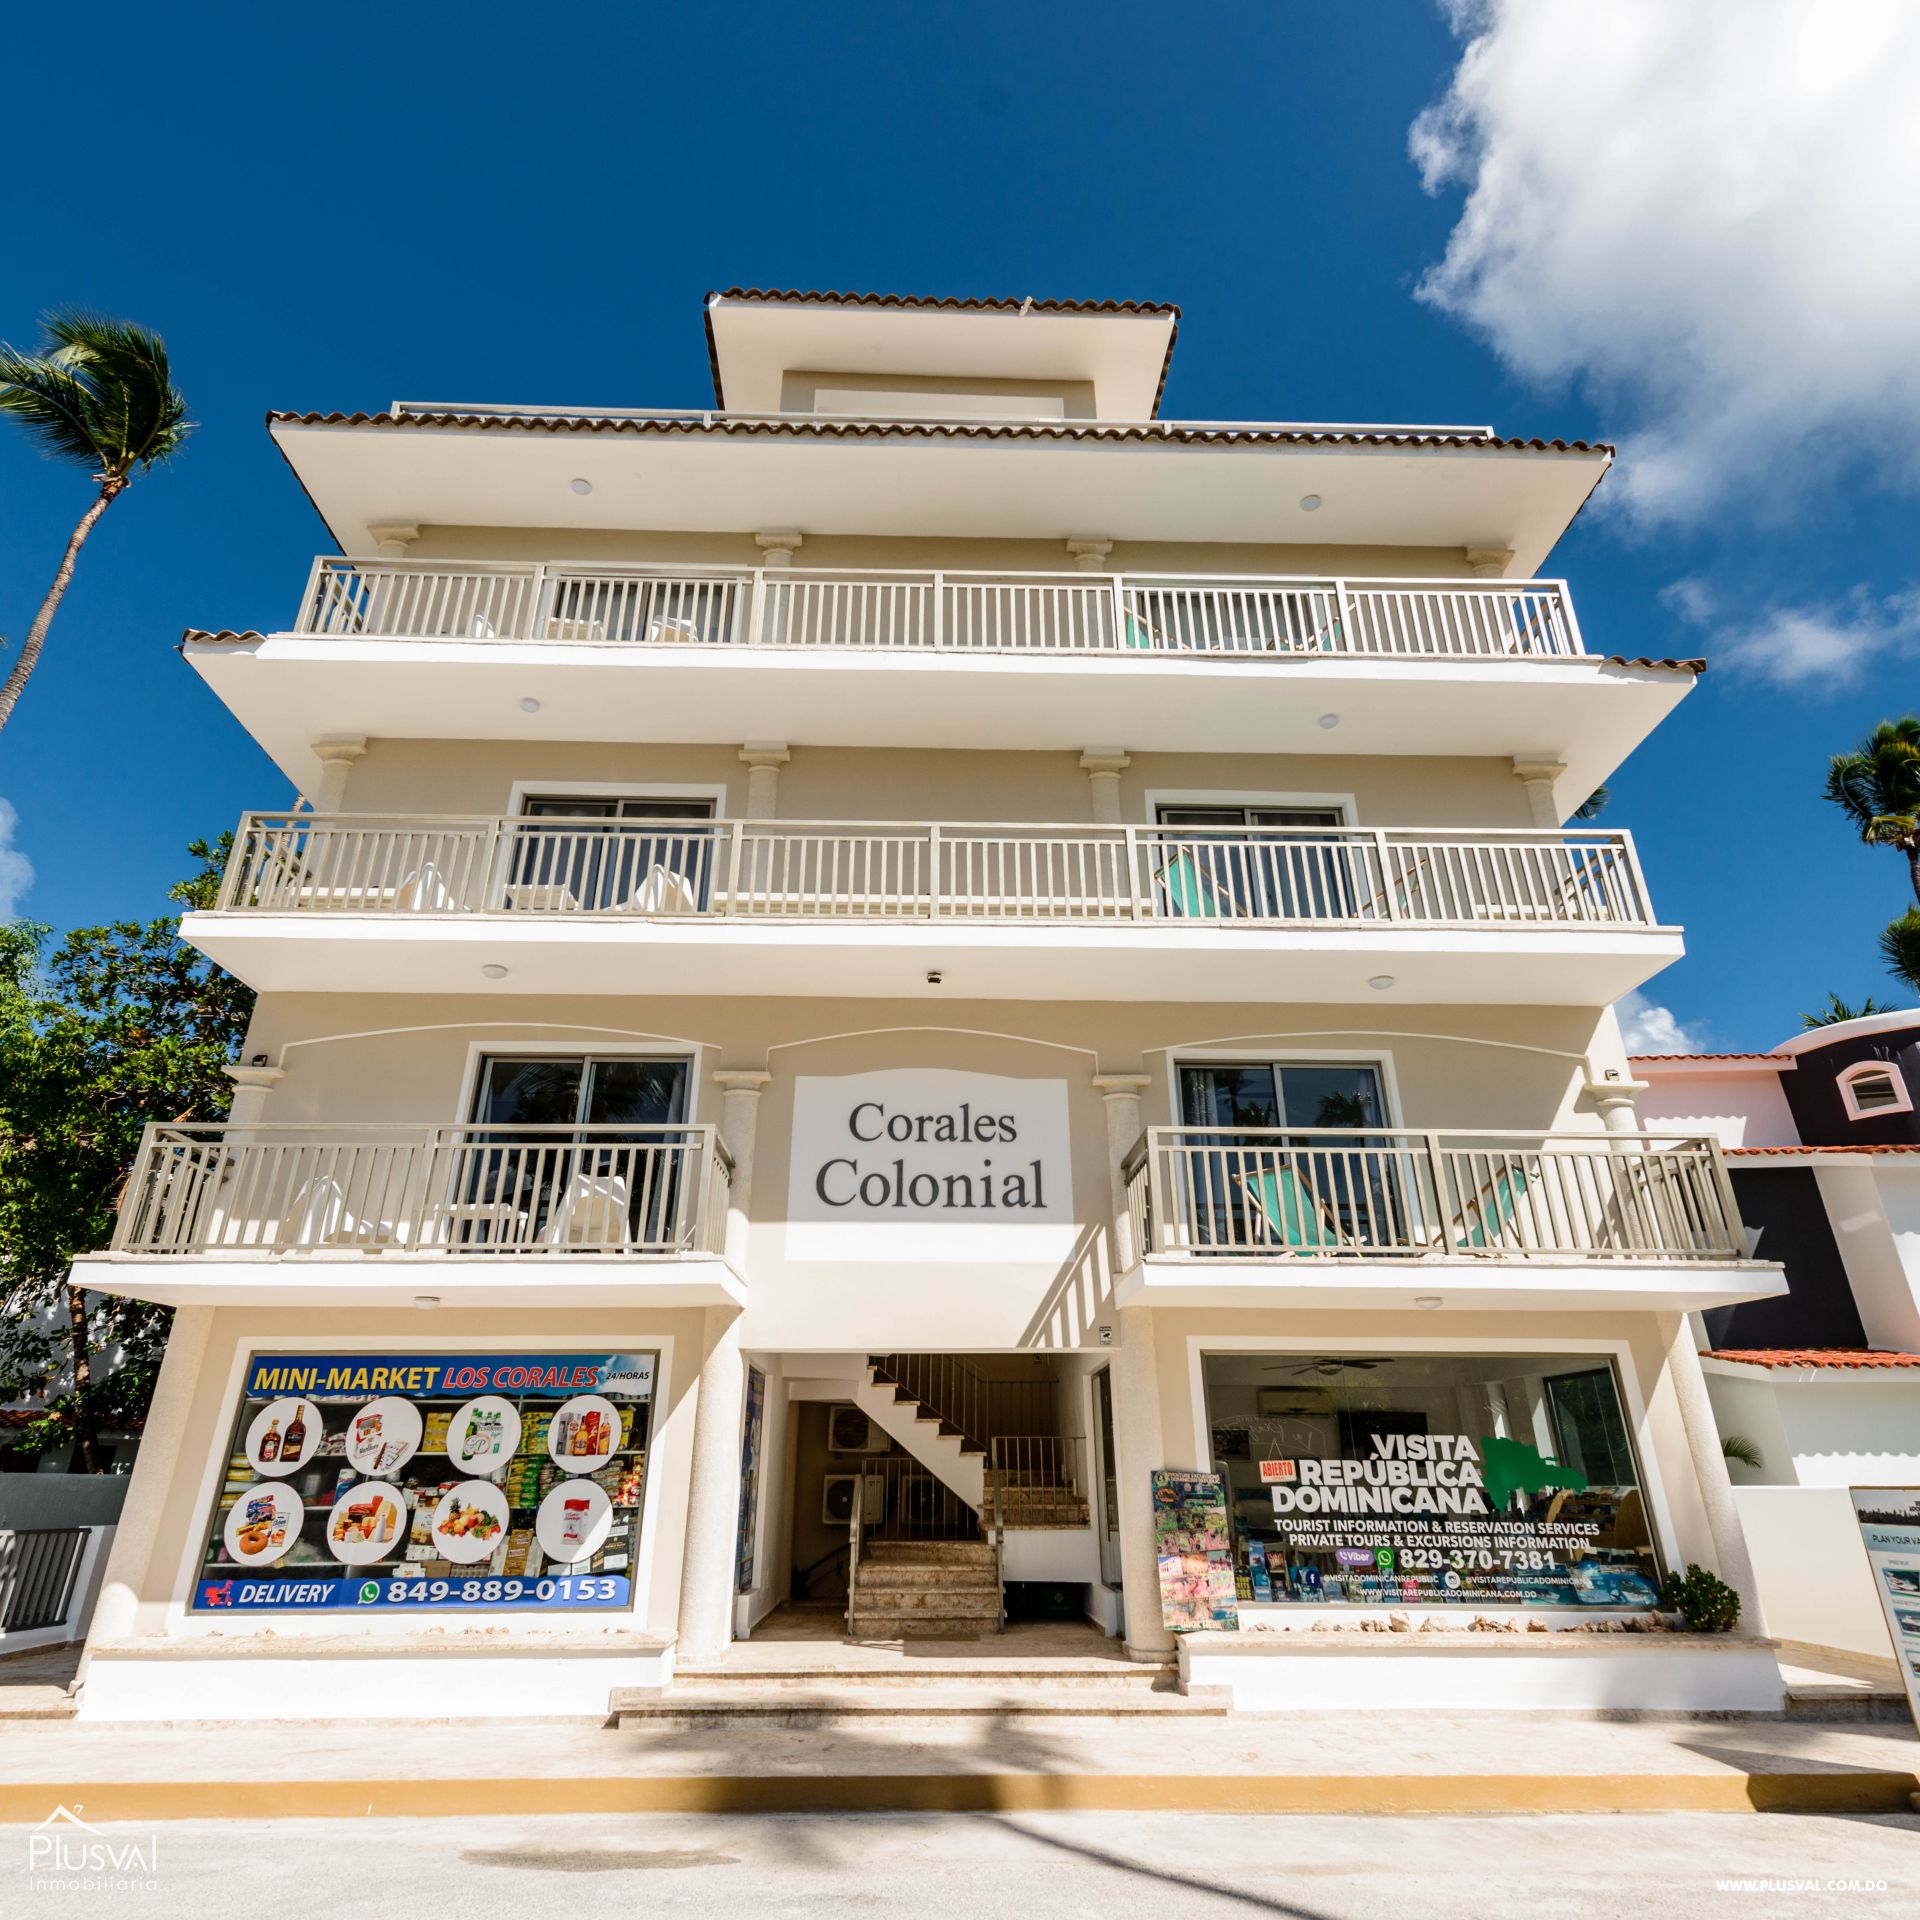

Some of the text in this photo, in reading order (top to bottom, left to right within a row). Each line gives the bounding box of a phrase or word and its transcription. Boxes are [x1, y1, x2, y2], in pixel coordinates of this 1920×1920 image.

[849, 1102, 1018, 1143] Corales
[815, 1158, 1048, 1208] Colonial
[253, 1366, 650, 1391] MINI-MARKET LOS CORALES 24/HORAS
[1370, 1433, 1480, 1461] VISITA
[1262, 1461, 1293, 1477] ABIERTO
[1298, 1452, 1485, 1488] REPÚBLICA
[1271, 1485, 1489, 1514] DOMINICANA
[1274, 1519, 1600, 1536] TOURIST INFORMATION & RESERVATION SERVICES
[1872, 1534, 1890, 1543] PLAN
[1890, 1536, 1911, 1545] YOUR
[1289, 1533, 1590, 1550] PRIVATE TOURS & EXCURSIONS INFORMATION
[1349, 1549, 1556, 1570] Viber 829-370-7381
[239, 1579, 616, 1603] DELIVERY 849-889-0153
[1360, 1588, 1537, 1598] WWW.VISITAREPUBLICADOMINICANA.COM.DO
